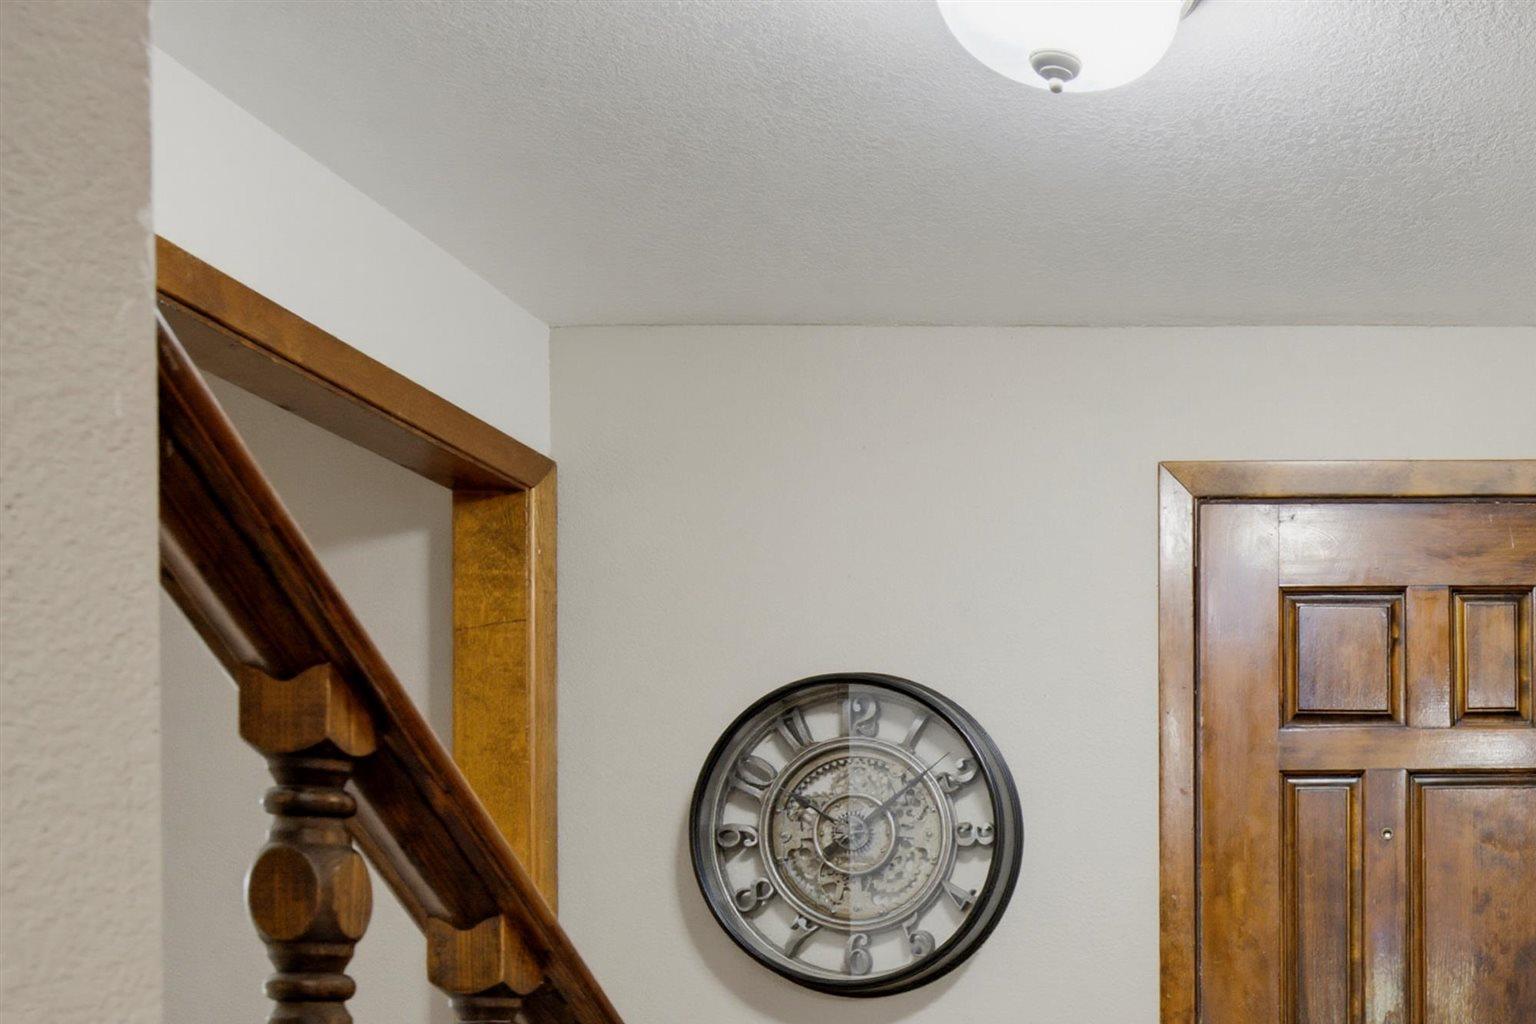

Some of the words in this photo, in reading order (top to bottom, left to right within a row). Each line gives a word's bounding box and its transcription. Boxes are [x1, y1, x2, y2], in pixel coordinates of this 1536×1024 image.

[841, 693, 881, 739] 12
[717, 823, 758, 848] 9
[734, 877, 775, 914] 8
[849, 932, 874, 976] 6
